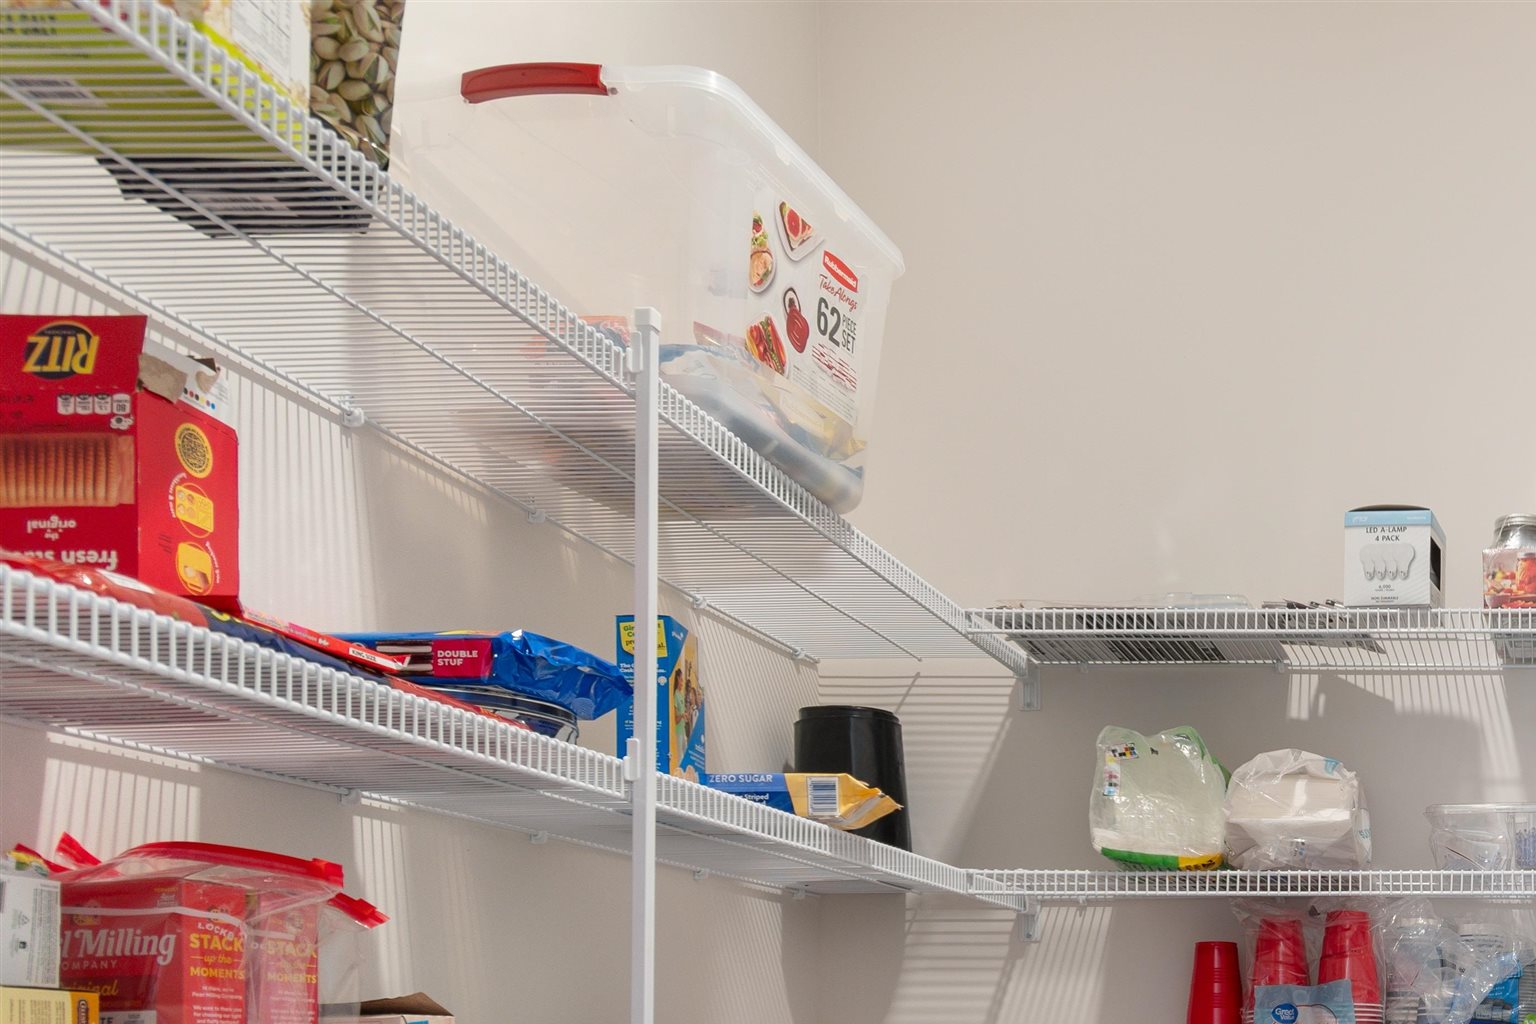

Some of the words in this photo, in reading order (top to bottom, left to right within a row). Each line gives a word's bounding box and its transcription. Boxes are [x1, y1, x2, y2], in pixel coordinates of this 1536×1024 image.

[824, 256, 858, 289] Rubbermaid
[817, 296, 842, 348] 62
[842, 313, 857, 336] PIECE
[841, 332, 856, 354] SET
[22, 334, 99, 375] RITZ
[27, 515, 77, 533] original
[1366, 526, 1378, 534] LED
[1380, 526, 1407, 534] A-LAMP
[45, 532, 59, 541] the
[60, 550, 118, 568] fresh
[352, 650, 365, 659] KING
[437, 650, 478, 658] DOUBLE
[437, 658, 464, 666] STUF
[709, 774, 736, 783] ZERO
[738, 774, 773, 783] SUGAR
[744, 793, 769, 801] Striped
[74, 928, 178, 966] Milling
[190, 933, 245, 952] STACK
[61, 959, 118, 971] OMPANY
[203, 955, 216, 965] up
[190, 966, 245, 979] MOMENTS
[1275, 1007, 1294, 1016] Great
